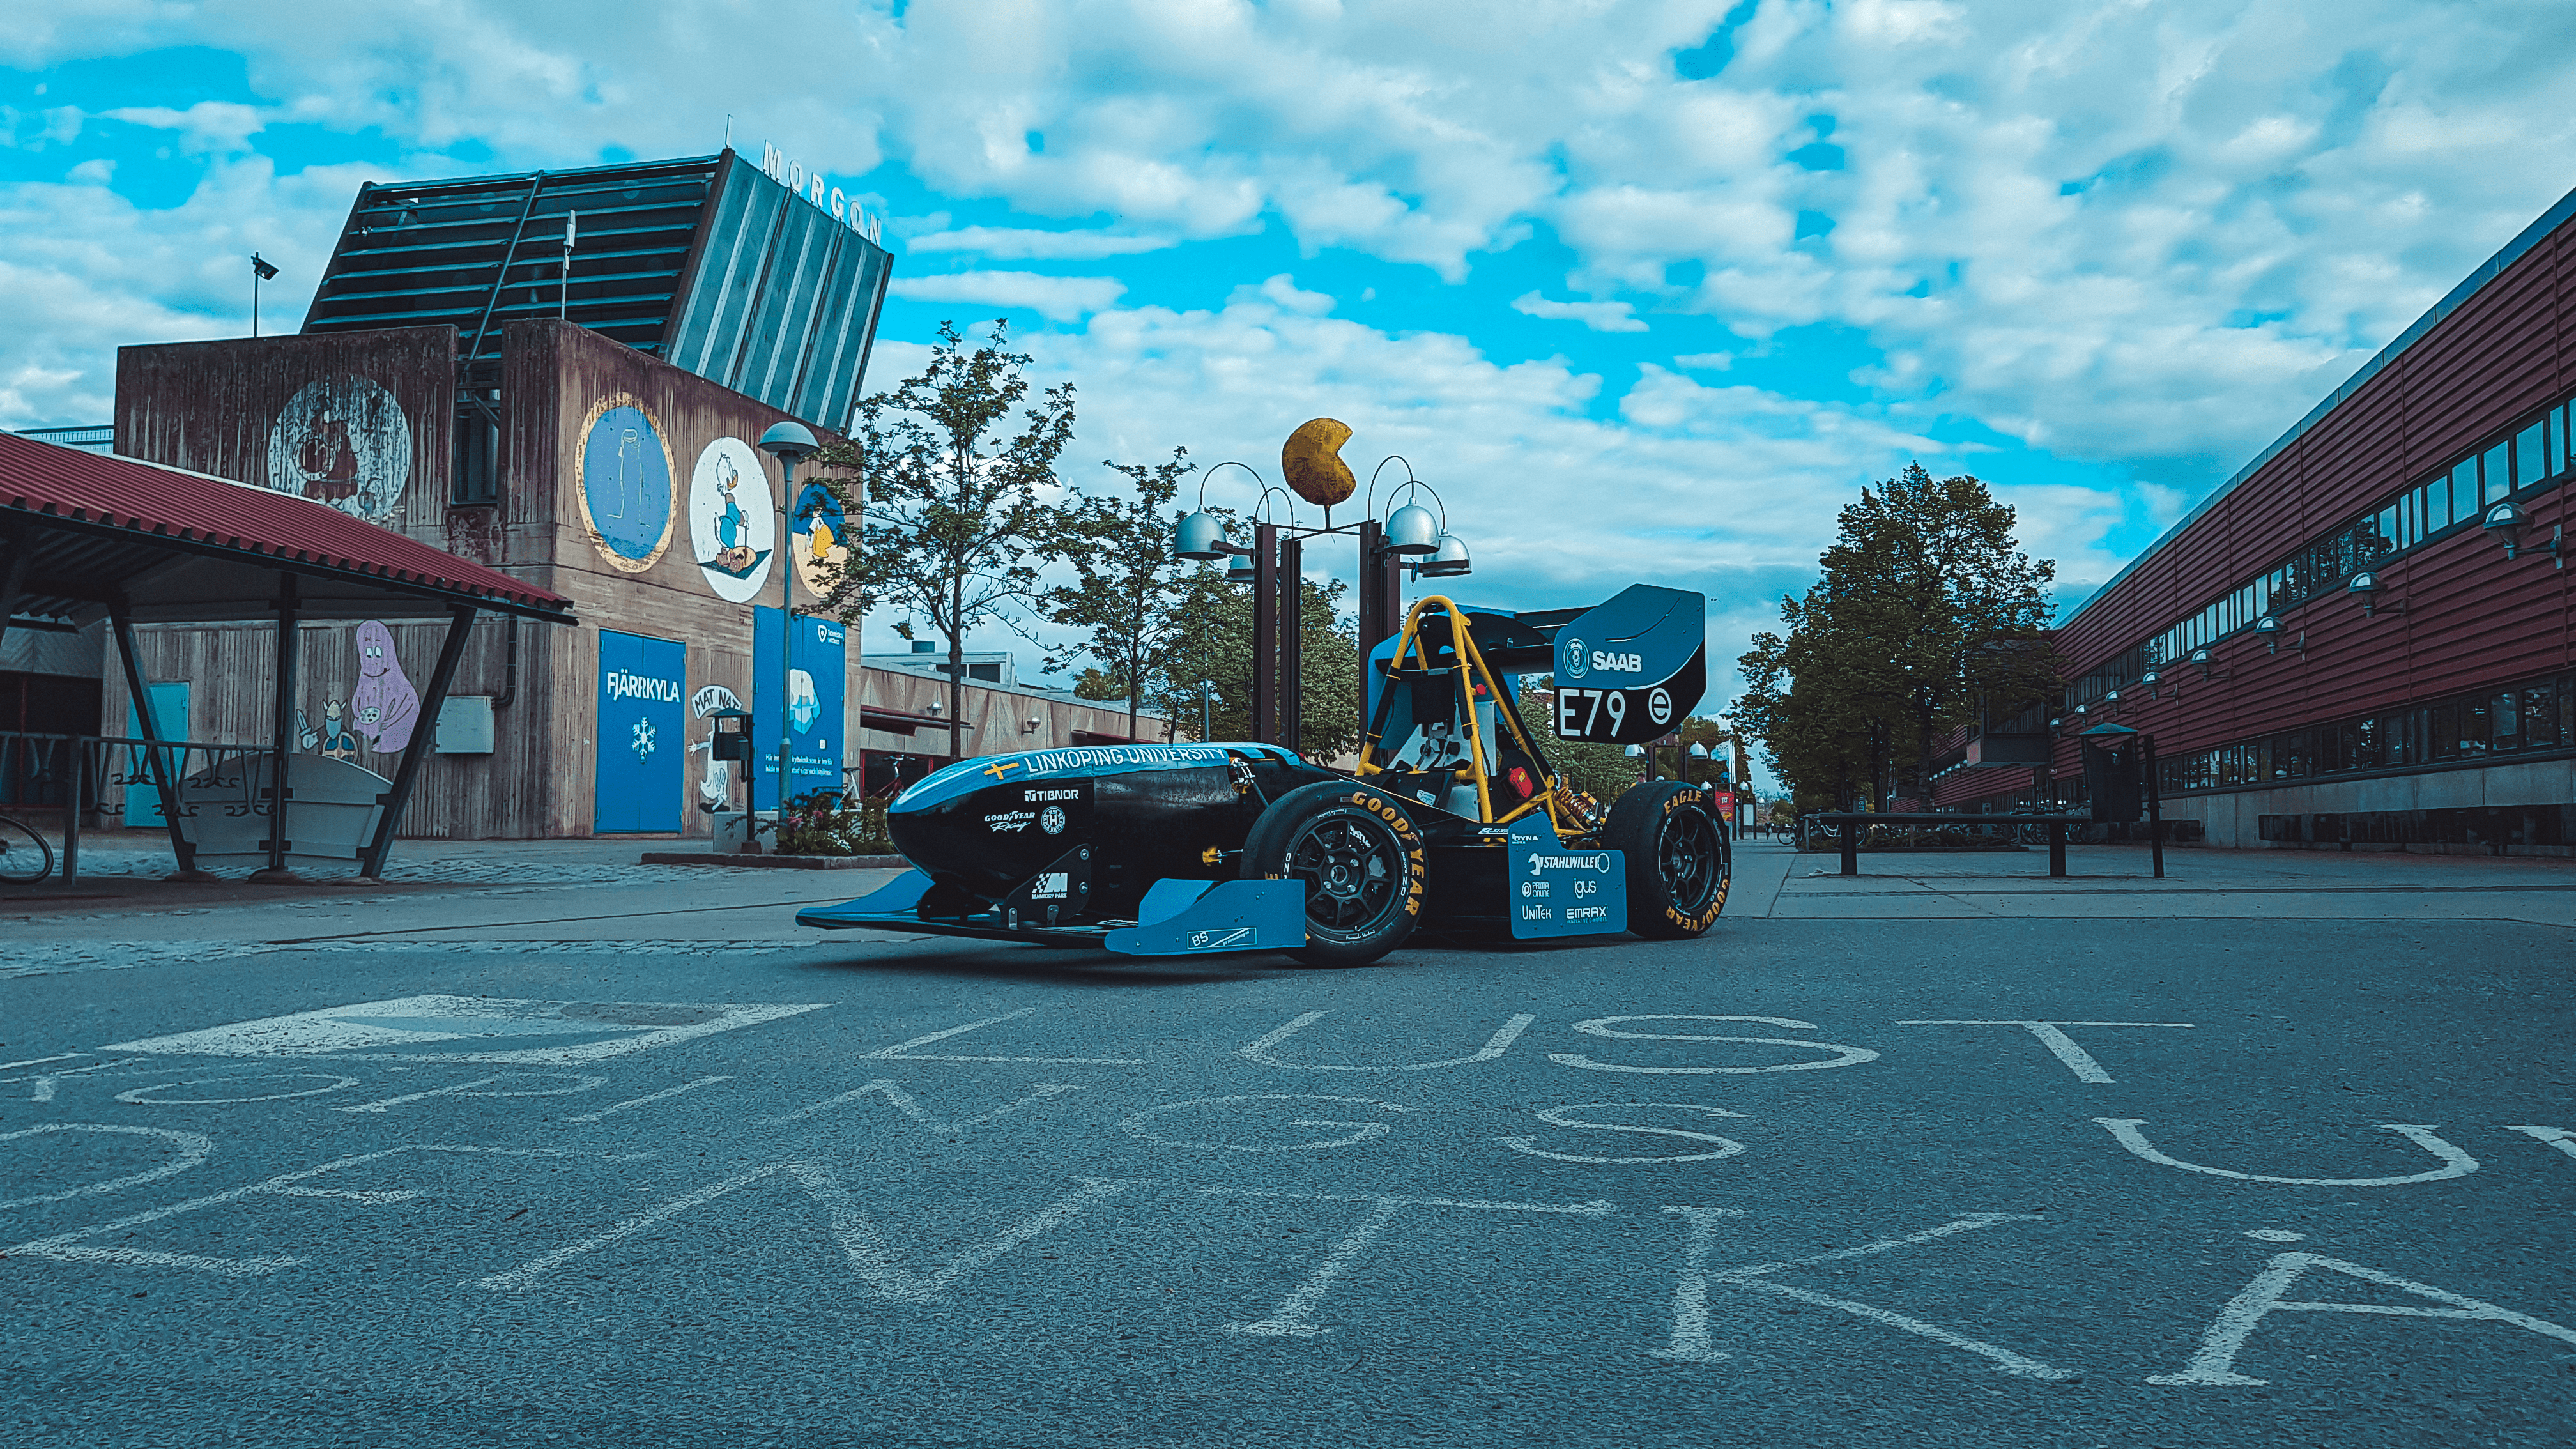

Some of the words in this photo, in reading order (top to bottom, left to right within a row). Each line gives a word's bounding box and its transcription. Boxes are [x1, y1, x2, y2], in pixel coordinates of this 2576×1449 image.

[763, 139, 882, 247] MORGON
[1592, 651, 1642, 672] SAAB
[607, 668, 680, 703] FJÄRRKYLA
[694, 688, 715, 716] MAT
[1560, 688, 1626, 737] E79
[1024, 748, 1124, 772] LINKÖPING
[1125, 747, 1225, 763] UNIVERSITY
[1036, 789, 1079, 801] TIBNOR
[1664, 790, 1702, 816] EAGLE
[984, 810, 1035, 822] GOODYEAR
[1352, 792, 1425, 916] GOODYEAR
[1532, 881, 1549, 890] PRIMA
[1532, 889, 1550, 898] ONLINE
[1574, 877, 1597, 900] igus
[1566, 906, 1607, 919] EMRAX
[1666, 878, 1729, 931] GOODYEAR
[1192, 931, 1209, 947] BS
